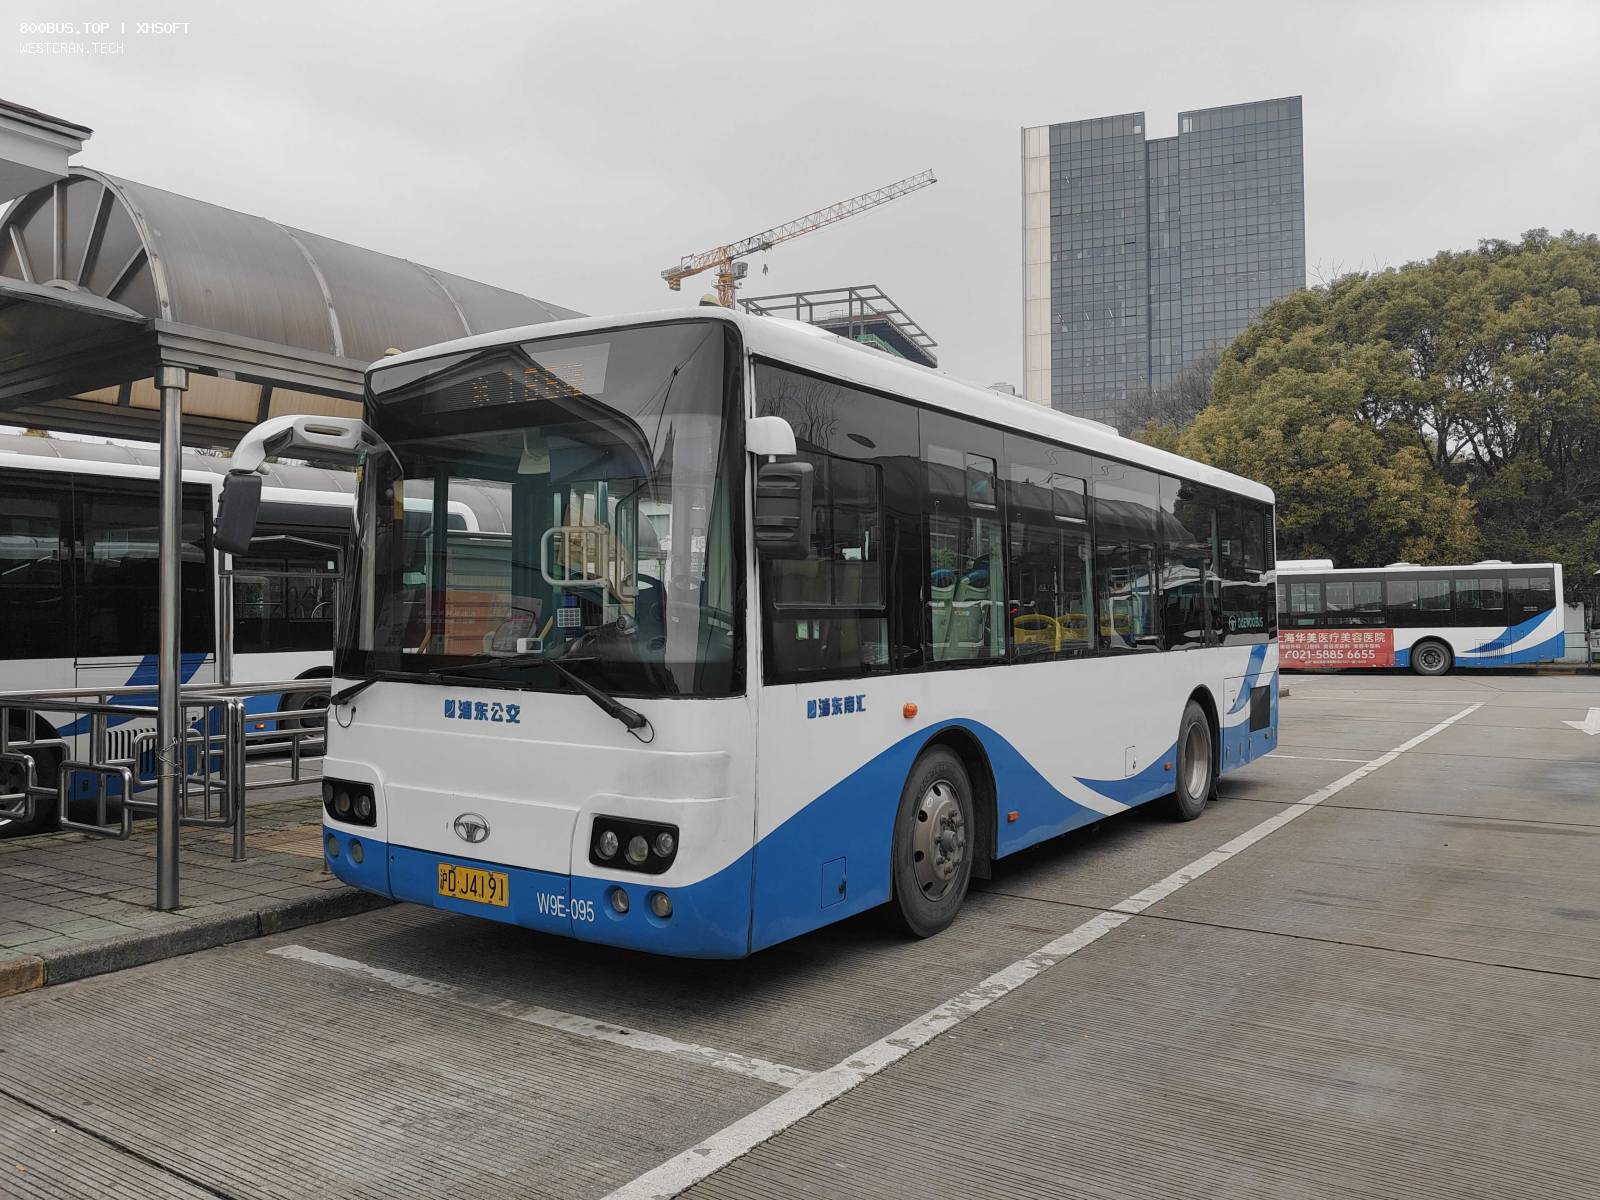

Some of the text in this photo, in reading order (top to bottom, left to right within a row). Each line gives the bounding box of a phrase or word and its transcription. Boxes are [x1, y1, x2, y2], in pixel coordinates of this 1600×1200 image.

[1291, 649, 1376, 660] 021-5885 6655
[458, 700, 521, 724] 浦东公交
[818, 694, 867, 718] 浦东南汇
[537, 892, 595, 923] W9E-095
